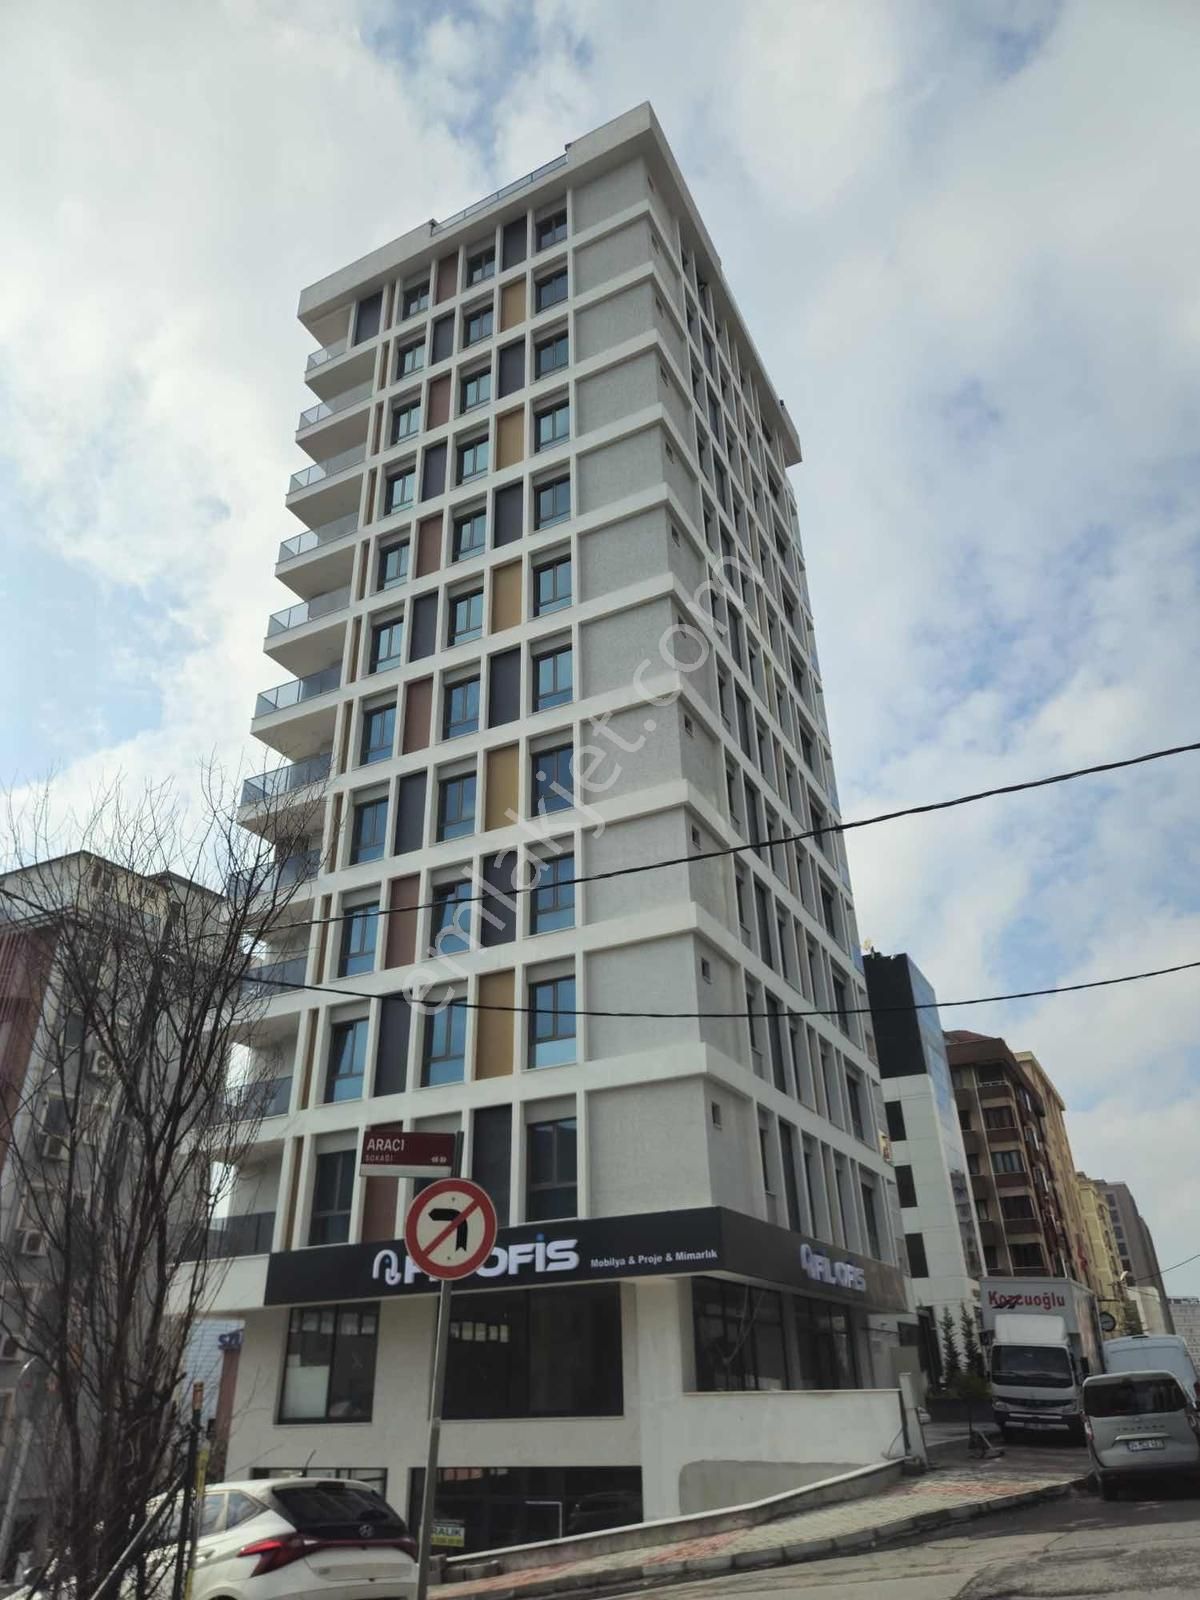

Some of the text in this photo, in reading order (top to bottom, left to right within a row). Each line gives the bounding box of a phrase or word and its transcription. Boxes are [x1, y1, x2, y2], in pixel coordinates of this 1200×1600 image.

[366, 1138, 405, 1152] ARACI
[590, 1249, 718, 1269] Mobilya & Proje & Mimarlık
